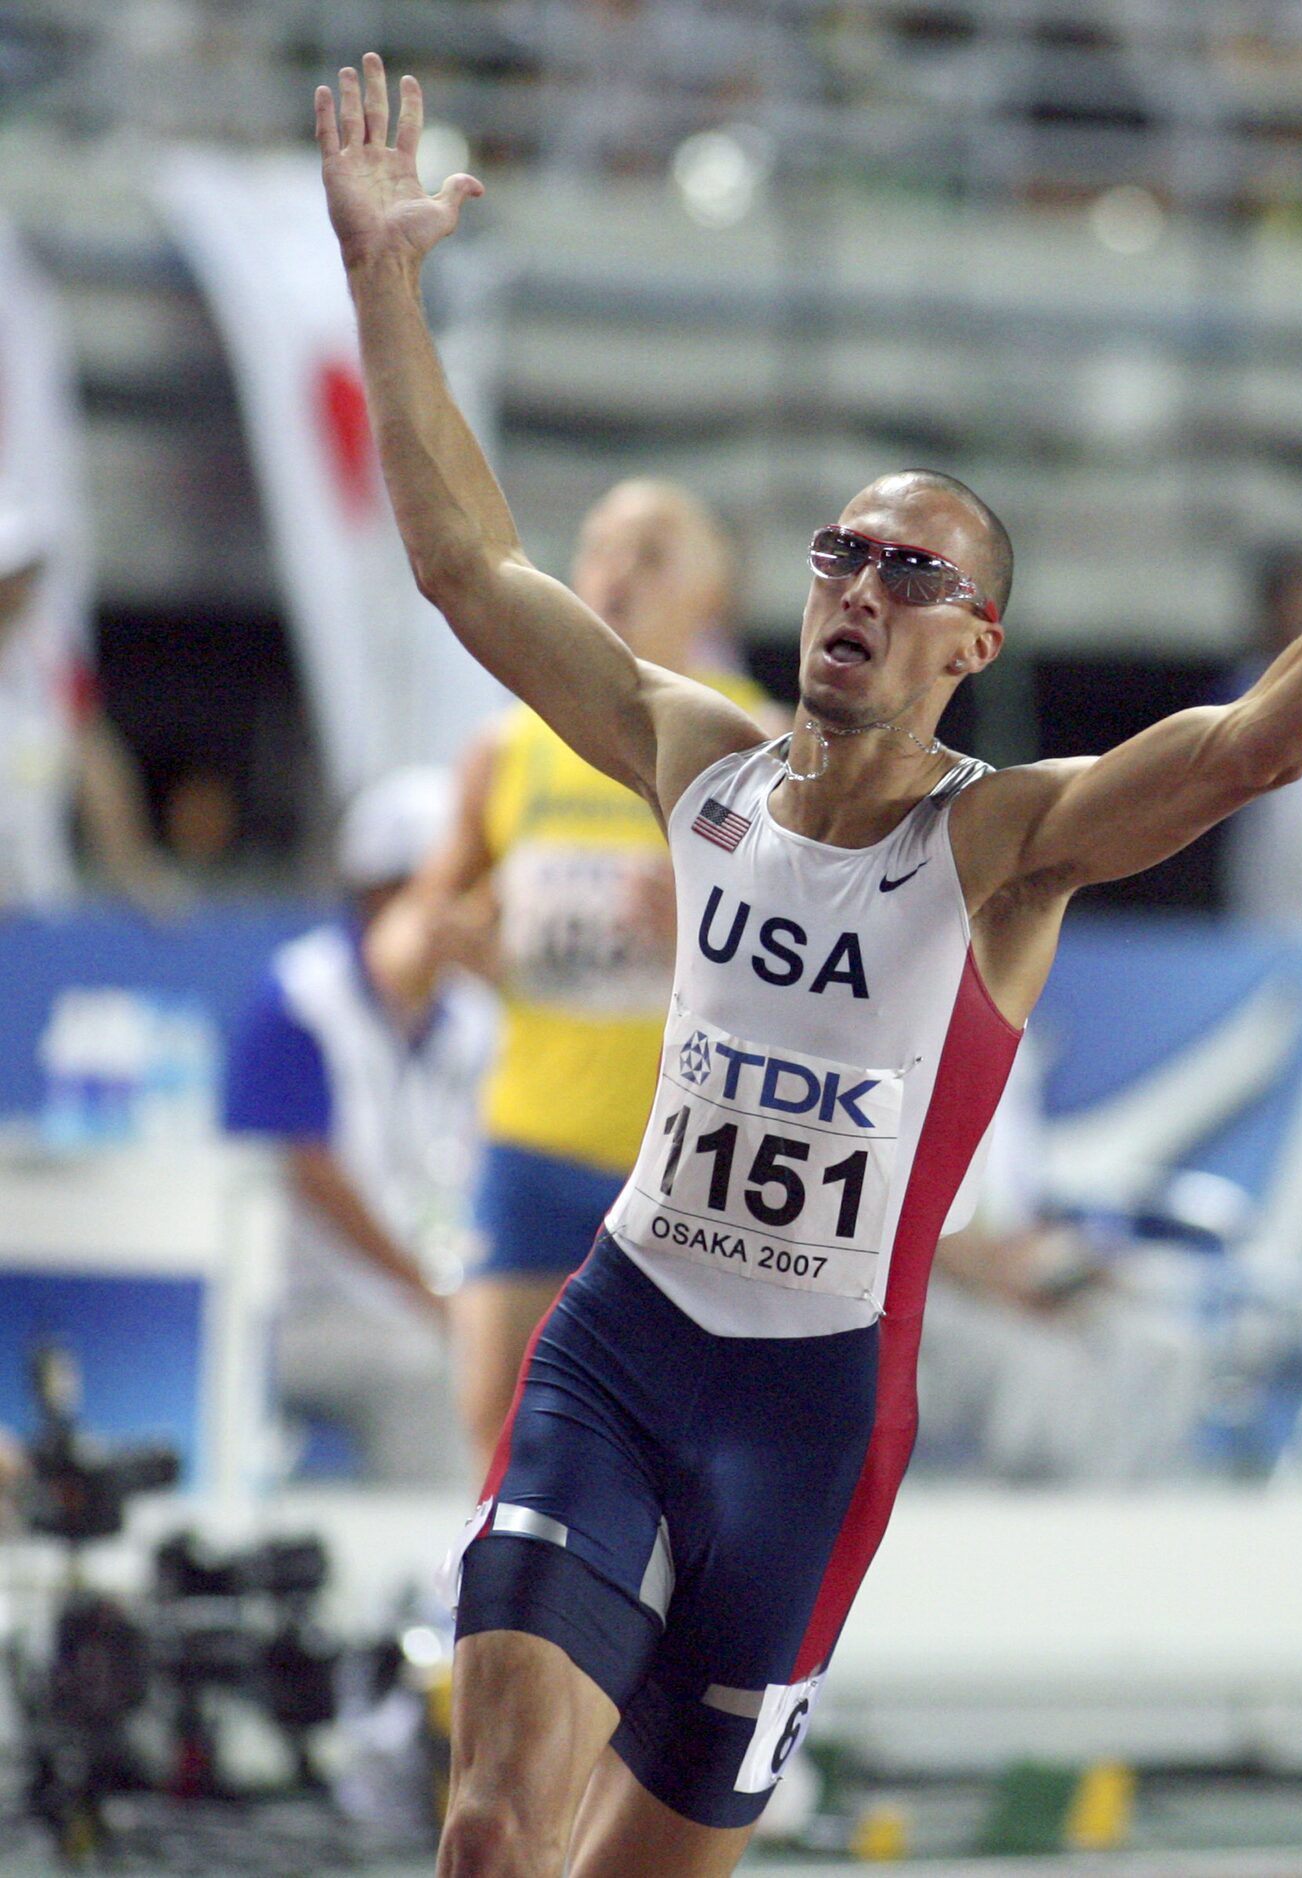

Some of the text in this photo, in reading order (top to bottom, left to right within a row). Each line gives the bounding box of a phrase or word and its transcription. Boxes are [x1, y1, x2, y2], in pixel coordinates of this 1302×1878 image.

[698, 885, 870, 1000] USA
[715, 1042, 881, 1128] TDK
[659, 1104, 870, 1239] 1151
[650, 1215, 828, 1279] OSAKA 2007
[771, 1698, 809, 1774] 6
